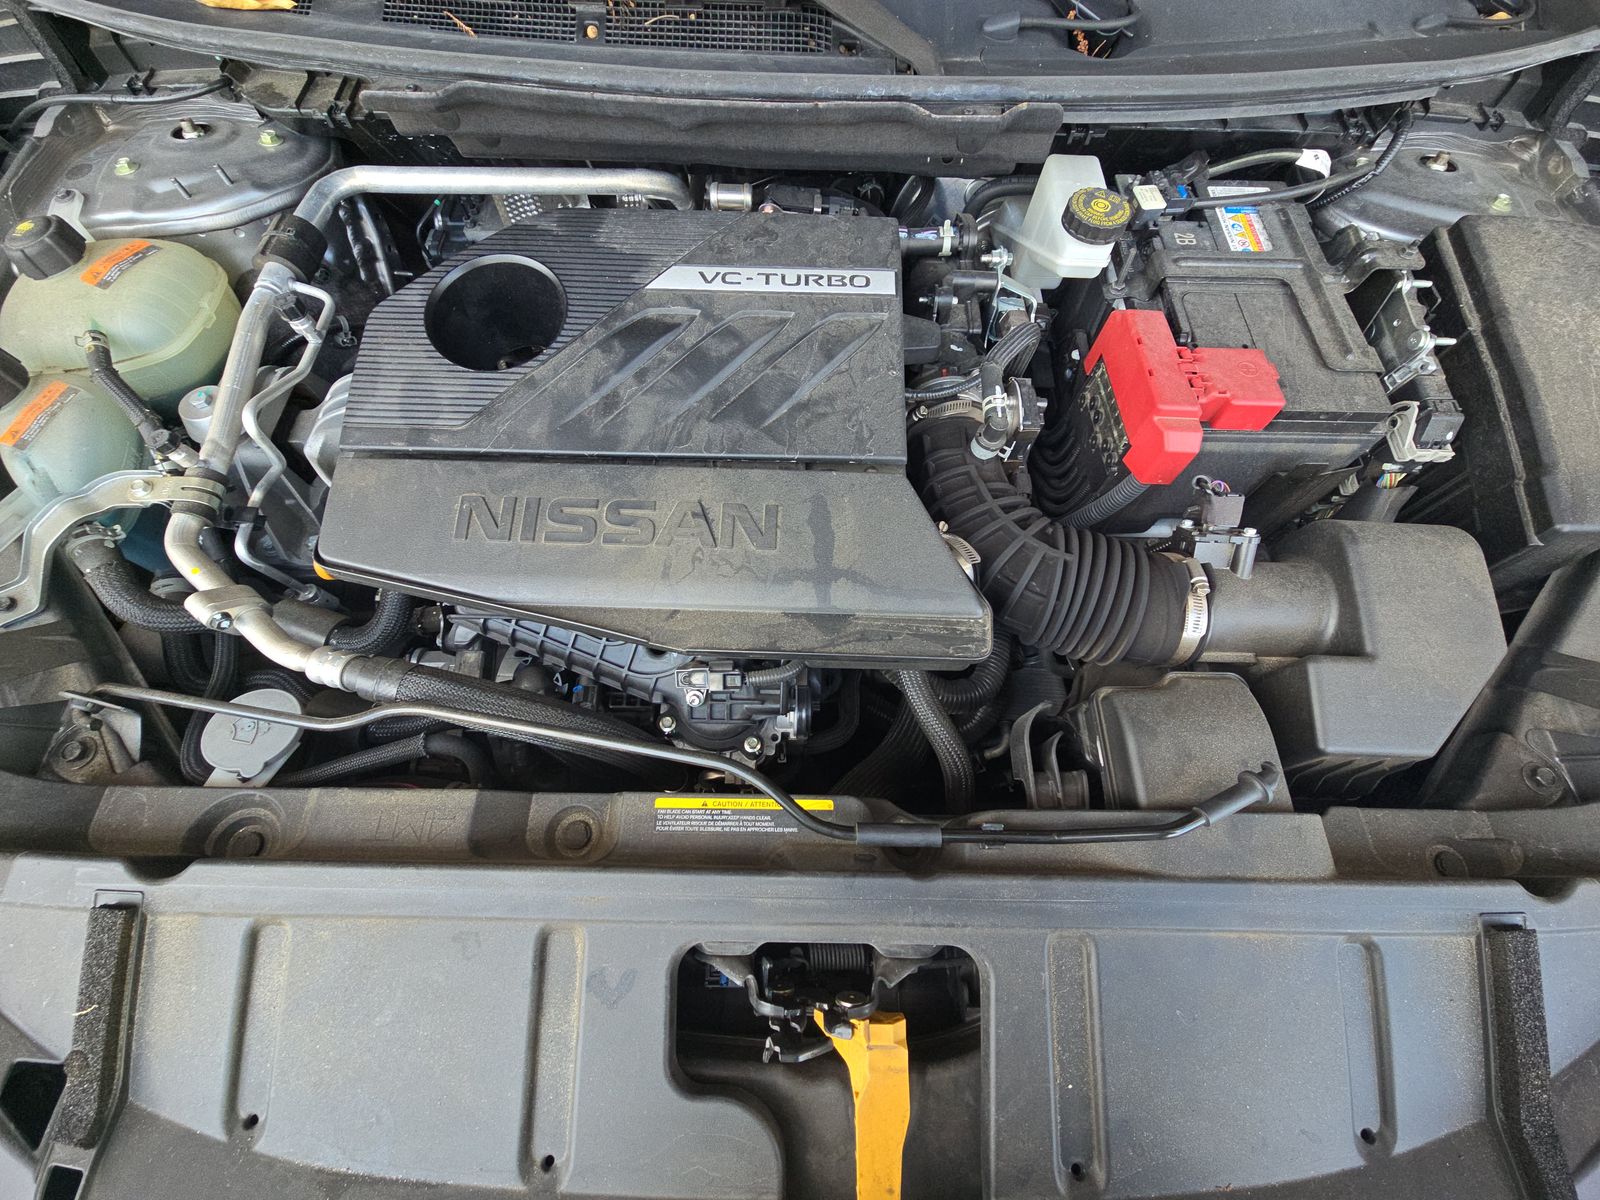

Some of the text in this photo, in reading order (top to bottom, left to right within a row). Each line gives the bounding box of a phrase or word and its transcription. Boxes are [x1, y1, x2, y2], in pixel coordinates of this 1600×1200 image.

[1174, 233, 1197, 245] 2B
[698, 271, 871, 288] VC-TURBO
[453, 494, 779, 551] NISSAN
